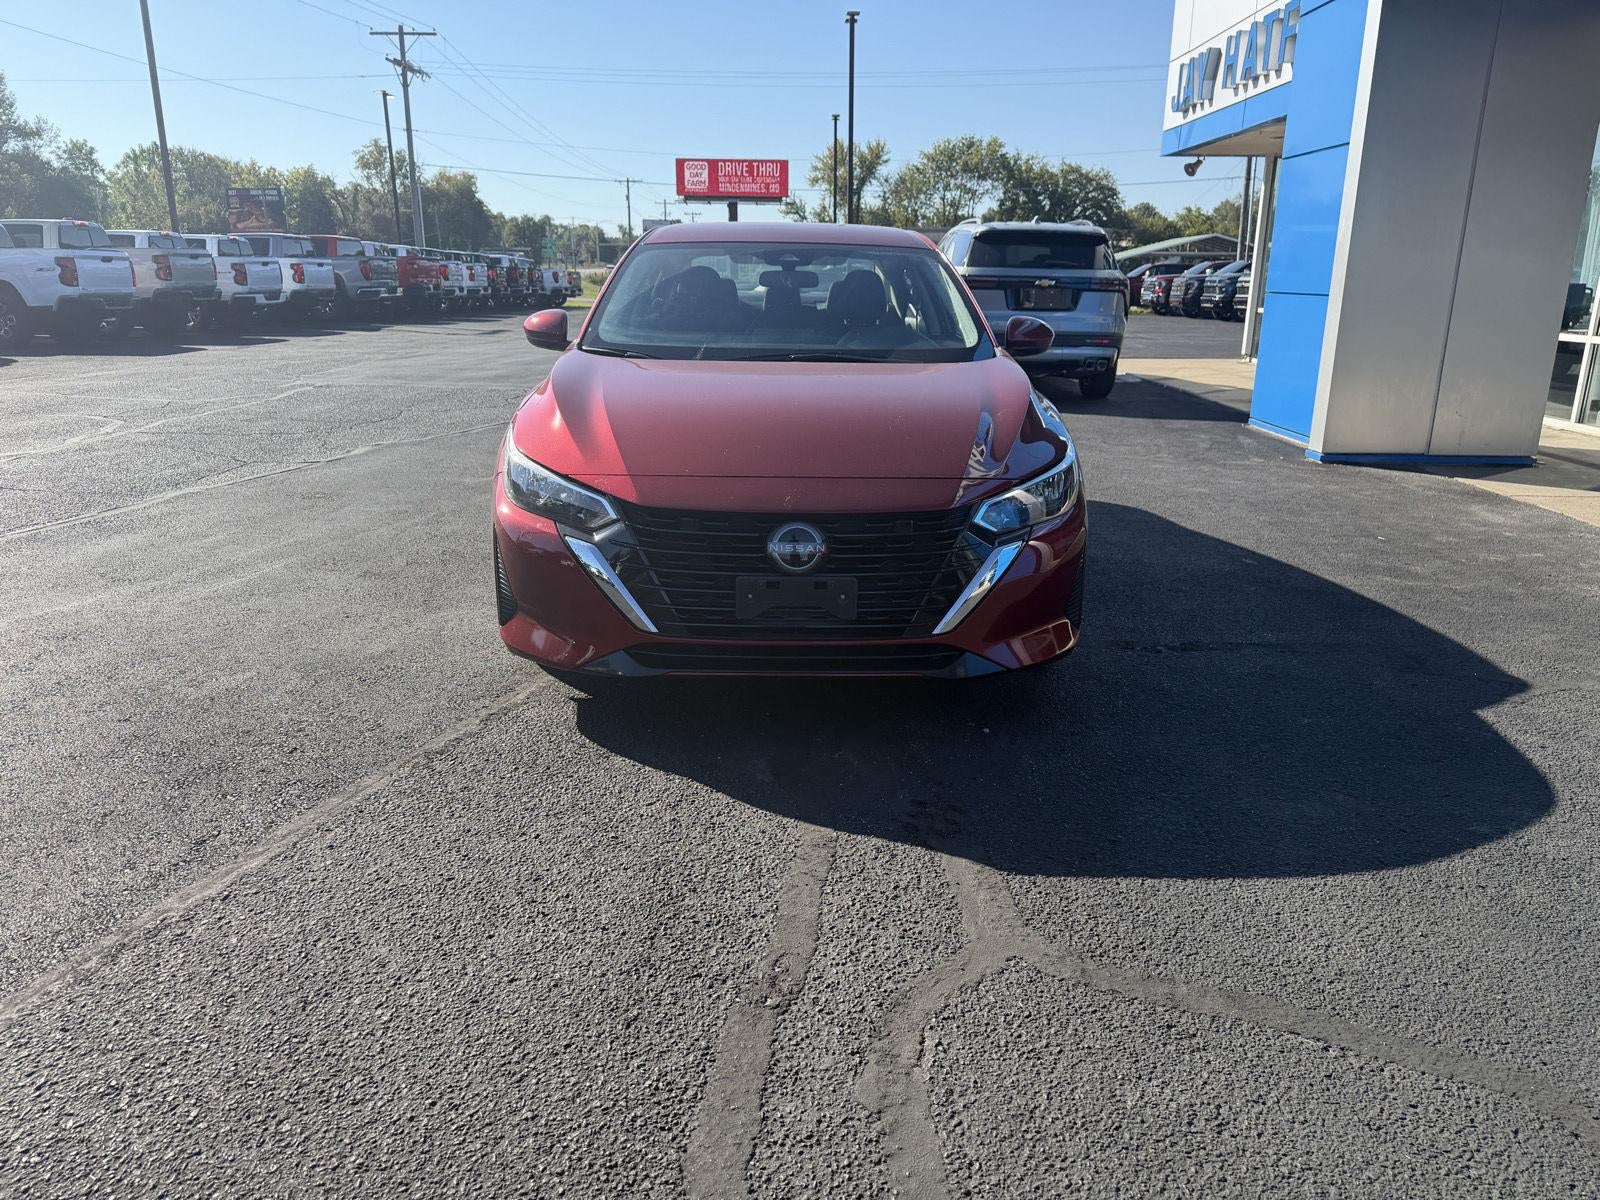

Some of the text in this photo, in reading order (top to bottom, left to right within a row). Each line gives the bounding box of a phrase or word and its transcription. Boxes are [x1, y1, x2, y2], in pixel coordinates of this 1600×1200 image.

[1171, 47, 1219, 113] JAY
[685, 163, 706, 171] GOOD
[718, 162, 780, 177] DRIVE THRU
[689, 171, 704, 179] DAY
[687, 179, 707, 188] FARM
[769, 544, 825, 553] NISSAN
